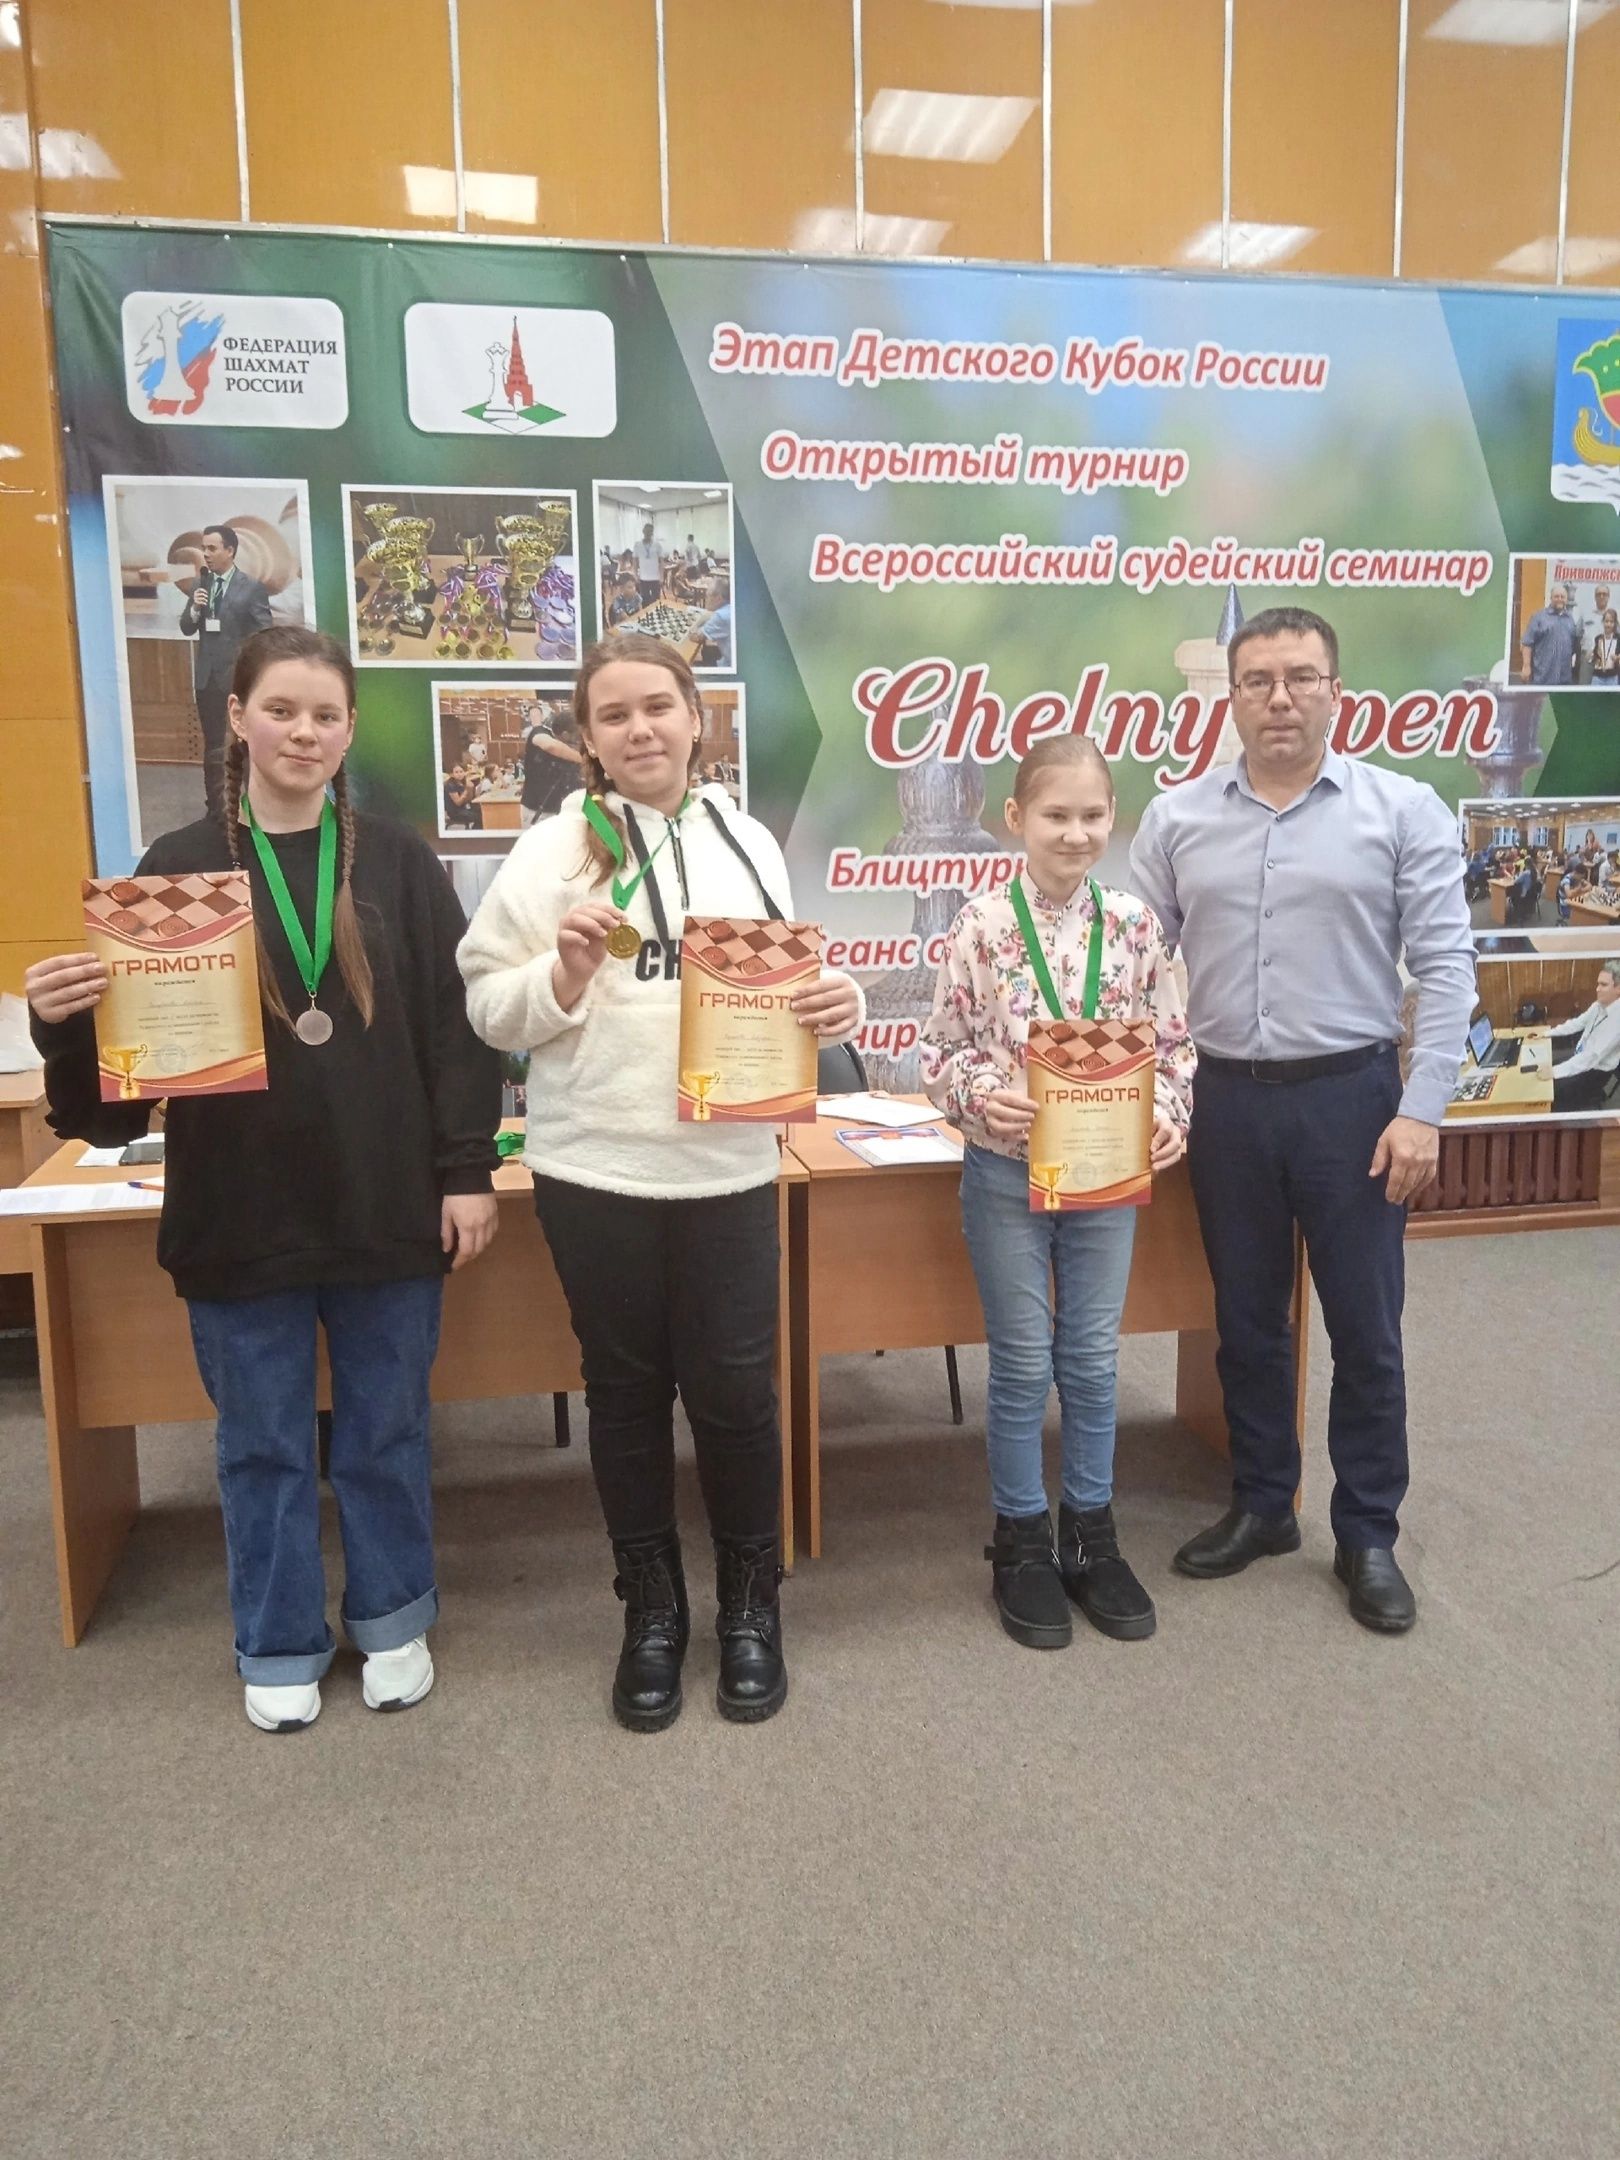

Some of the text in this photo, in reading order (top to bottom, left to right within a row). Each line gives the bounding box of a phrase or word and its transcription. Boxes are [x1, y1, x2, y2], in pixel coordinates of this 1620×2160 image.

[223, 337, 338, 356] ФЕДЕРАЦИЯ
[714, 328, 1326, 390] Этап Детского Кубок России
[224, 357, 310, 374] ШАХМАТ
[225, 377, 304, 394] РОССИИ
[765, 435, 1184, 490] Открытый турнир
[813, 538, 1490, 591] Всероссийский судейский семинар
[858, 664, 1496, 788] Chelny pen
[111, 953, 237, 976] ГРАМОТА
[822, 935, 917, 967] еанс
[1045, 1087, 1140, 1104] ГРАМОТА
